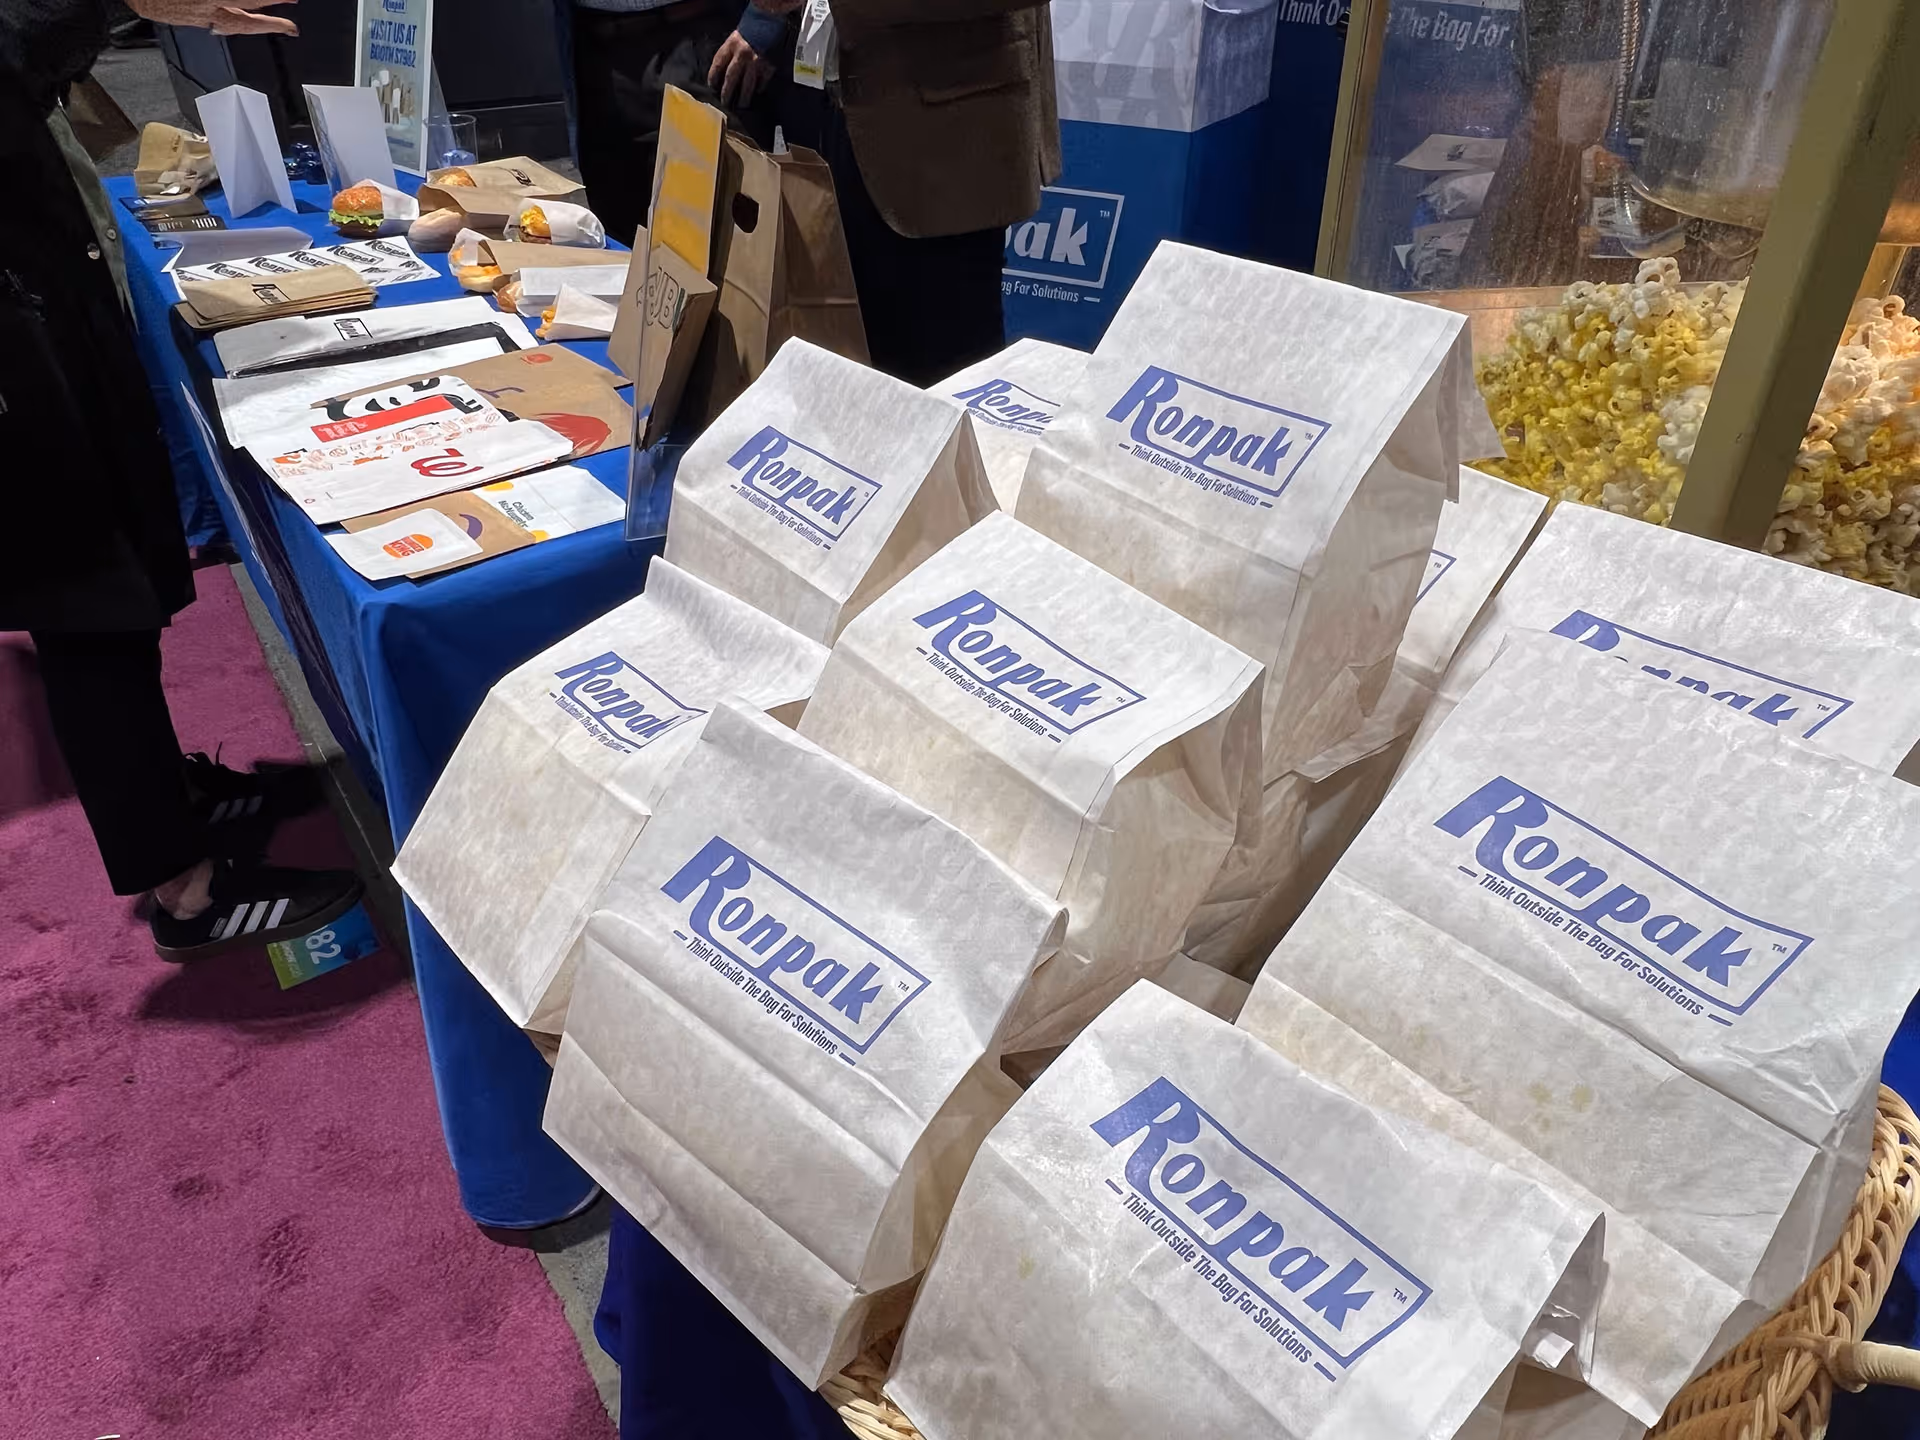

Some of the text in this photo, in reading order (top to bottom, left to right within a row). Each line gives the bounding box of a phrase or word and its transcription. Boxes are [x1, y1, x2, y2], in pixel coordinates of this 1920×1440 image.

[393, 22, 405, 44] US
[405, 24, 417, 46] AT
[1279, 0, 1321, 25] Think
[1430, 11, 1473, 51] Bag
[1472, 15, 1510, 48] For
[1014, 281, 1031, 295] For
[1032, 283, 1079, 302] Solutions
[1105, 364, 1294, 477] Ronpak
[726, 425, 857, 525] Ronpak
[1130, 444, 1260, 507] Think Outside The Bag For Solutions
[554, 650, 681, 739] Ronpak
[912, 589, 1102, 716] Ronpak
[926, 652, 1048, 737] Think Outside The Bag For Solutions
[660, 835, 884, 1025] Ronpak
[1433, 775, 1753, 988] Ronpak
[305, 929, 342, 966] 82
[1479, 873, 1705, 1016] Think Outside The Bag For Solutions
[686, 936, 839, 1055] Think Outside The Bag For Solutions
[1089, 1076, 1375, 1332] Ronpak
[1122, 1191, 1313, 1364] Think Outside The Bag For Solutions
